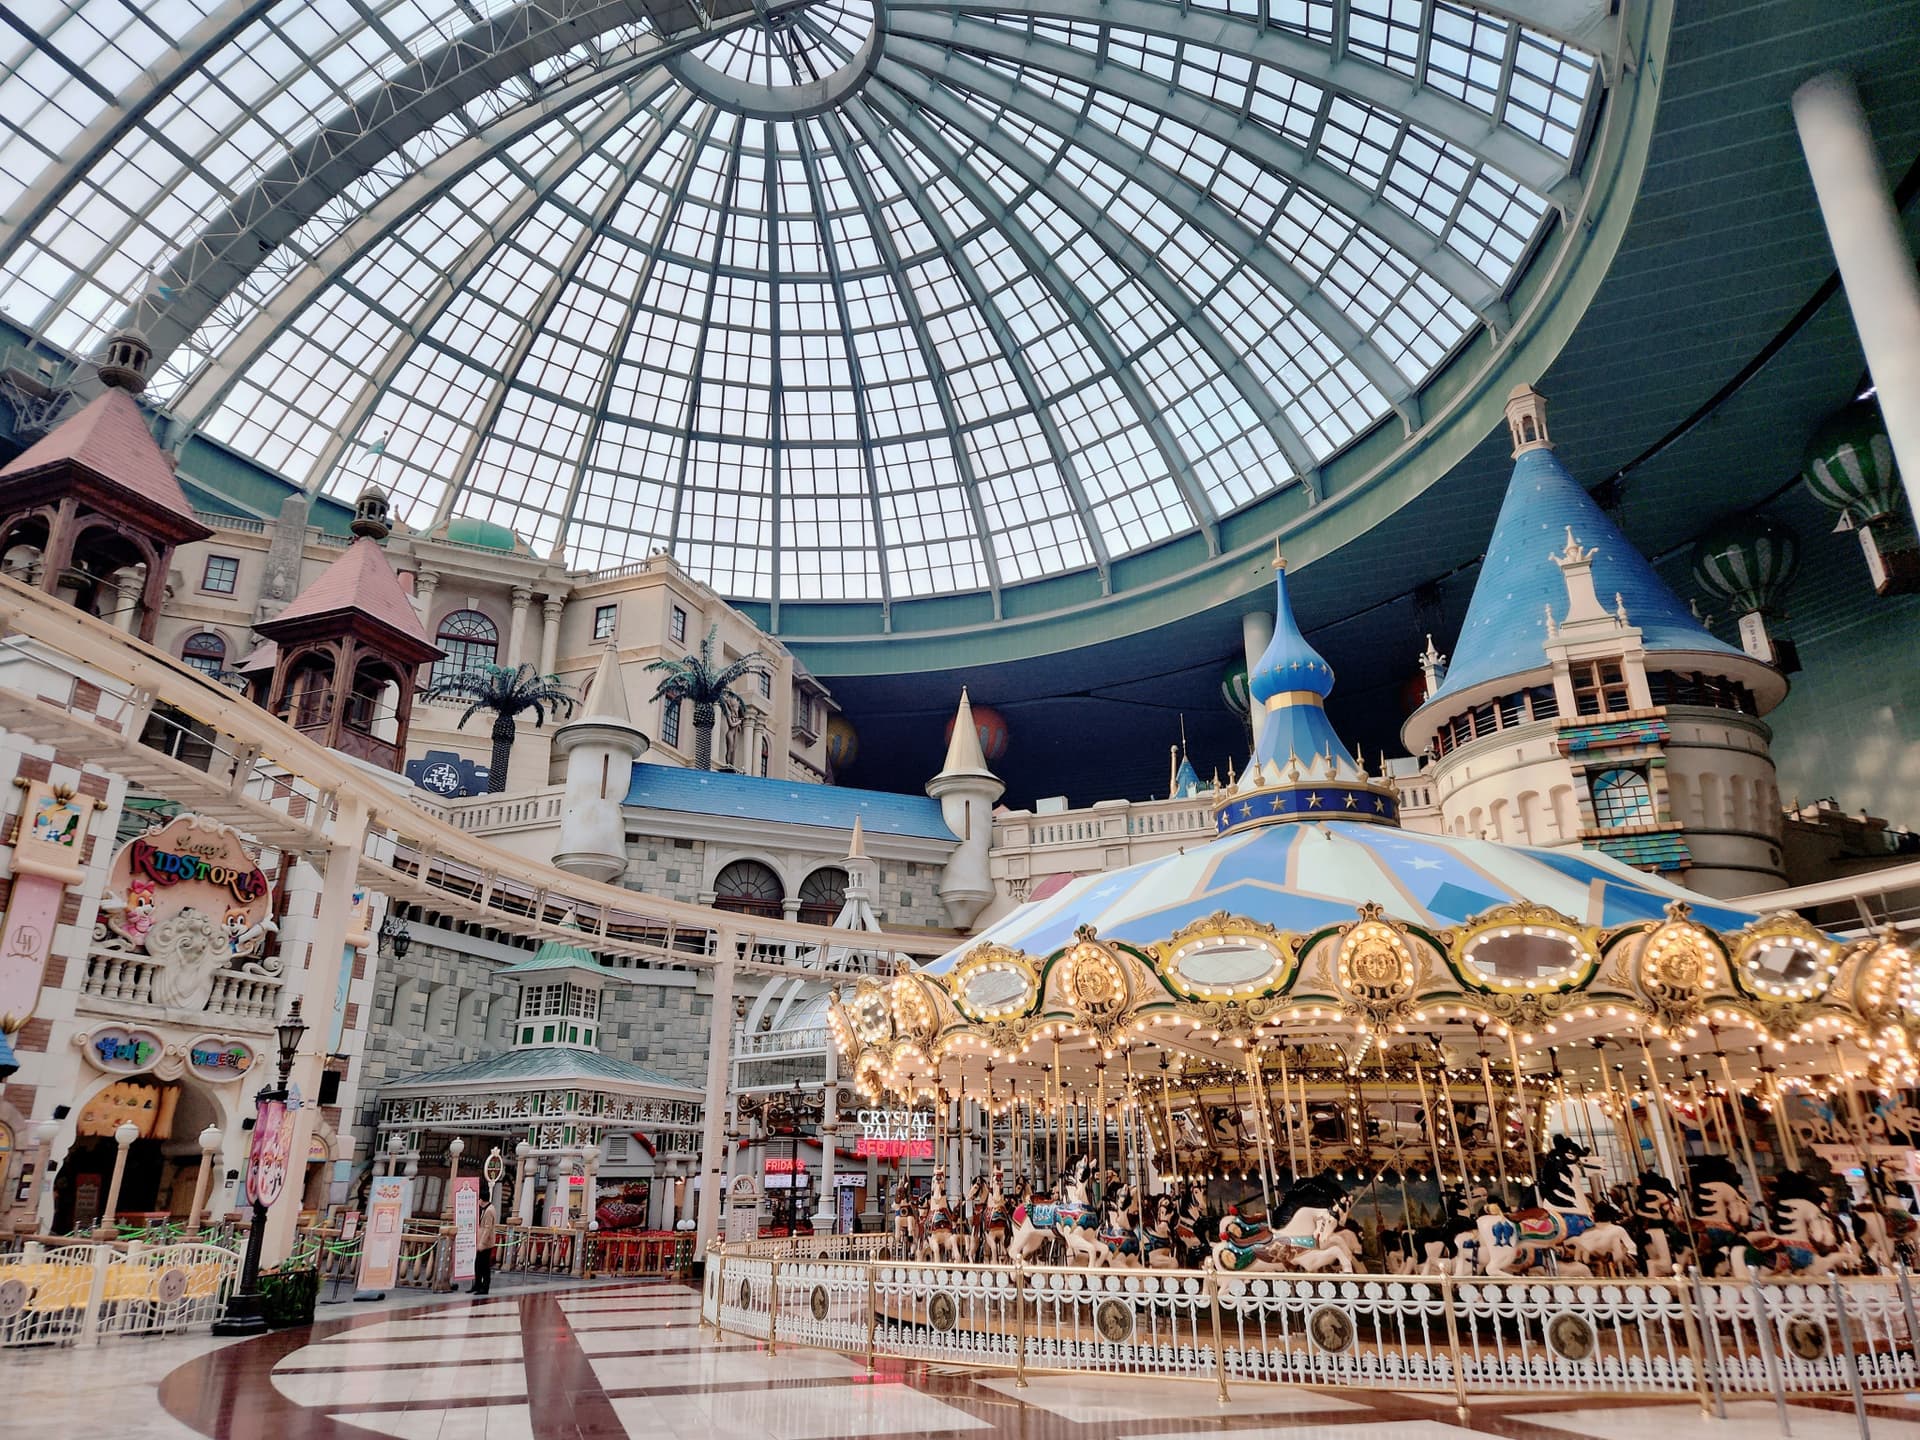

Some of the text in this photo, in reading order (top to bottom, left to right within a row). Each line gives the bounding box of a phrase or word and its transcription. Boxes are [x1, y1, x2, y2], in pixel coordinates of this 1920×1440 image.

[857, 1110, 932, 1127] CRYSTAL
[864, 1125, 927, 1141] PALACE
[765, 1159, 805, 1171] FRIDAS
